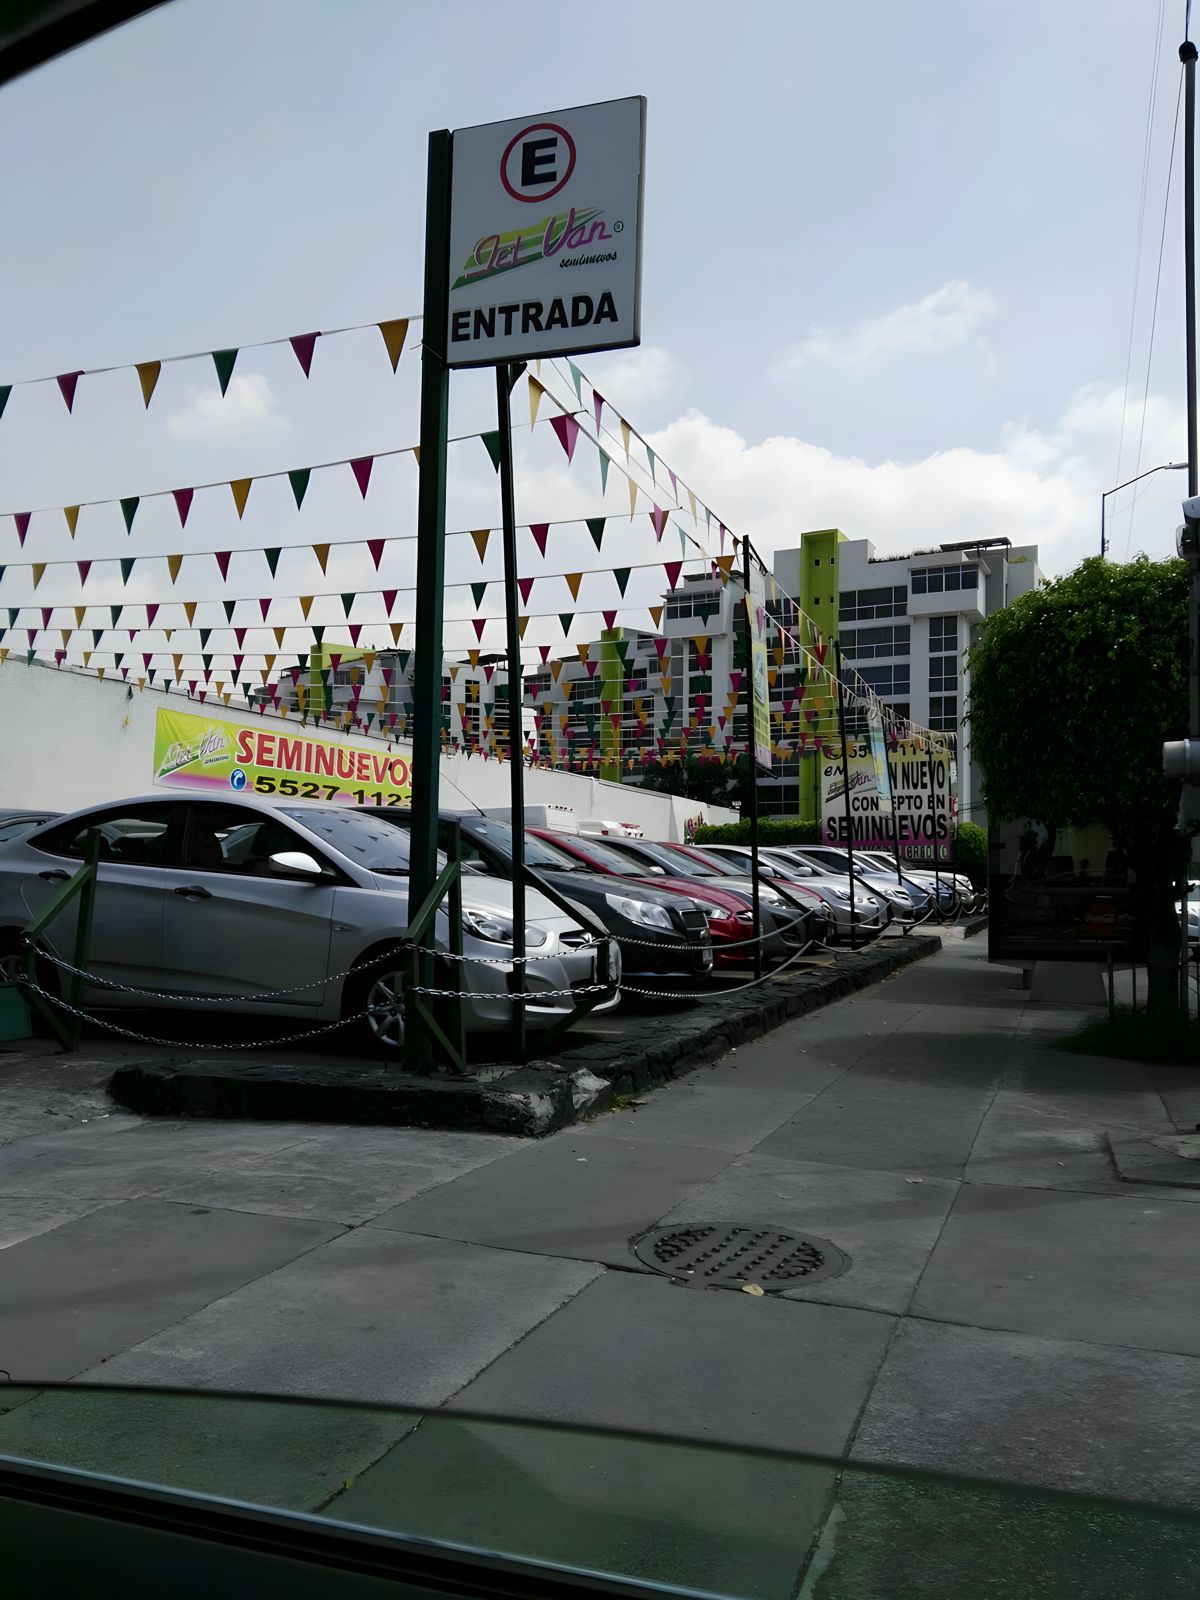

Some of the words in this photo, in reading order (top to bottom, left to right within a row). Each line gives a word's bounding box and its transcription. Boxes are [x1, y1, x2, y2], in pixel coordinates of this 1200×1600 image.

[520, 136, 558, 187] E
[541, 207, 613, 257] Van
[450, 291, 619, 343] ENTRADA
[235, 729, 412, 788] SEMINUEVO
[902, 760, 945, 790] NUEVO
[255, 775, 341, 801] 5527
[851, 795, 923, 811] CONEPTO
[928, 795, 945, 809] EN
[827, 814, 948, 841] SEMINUEVOS
